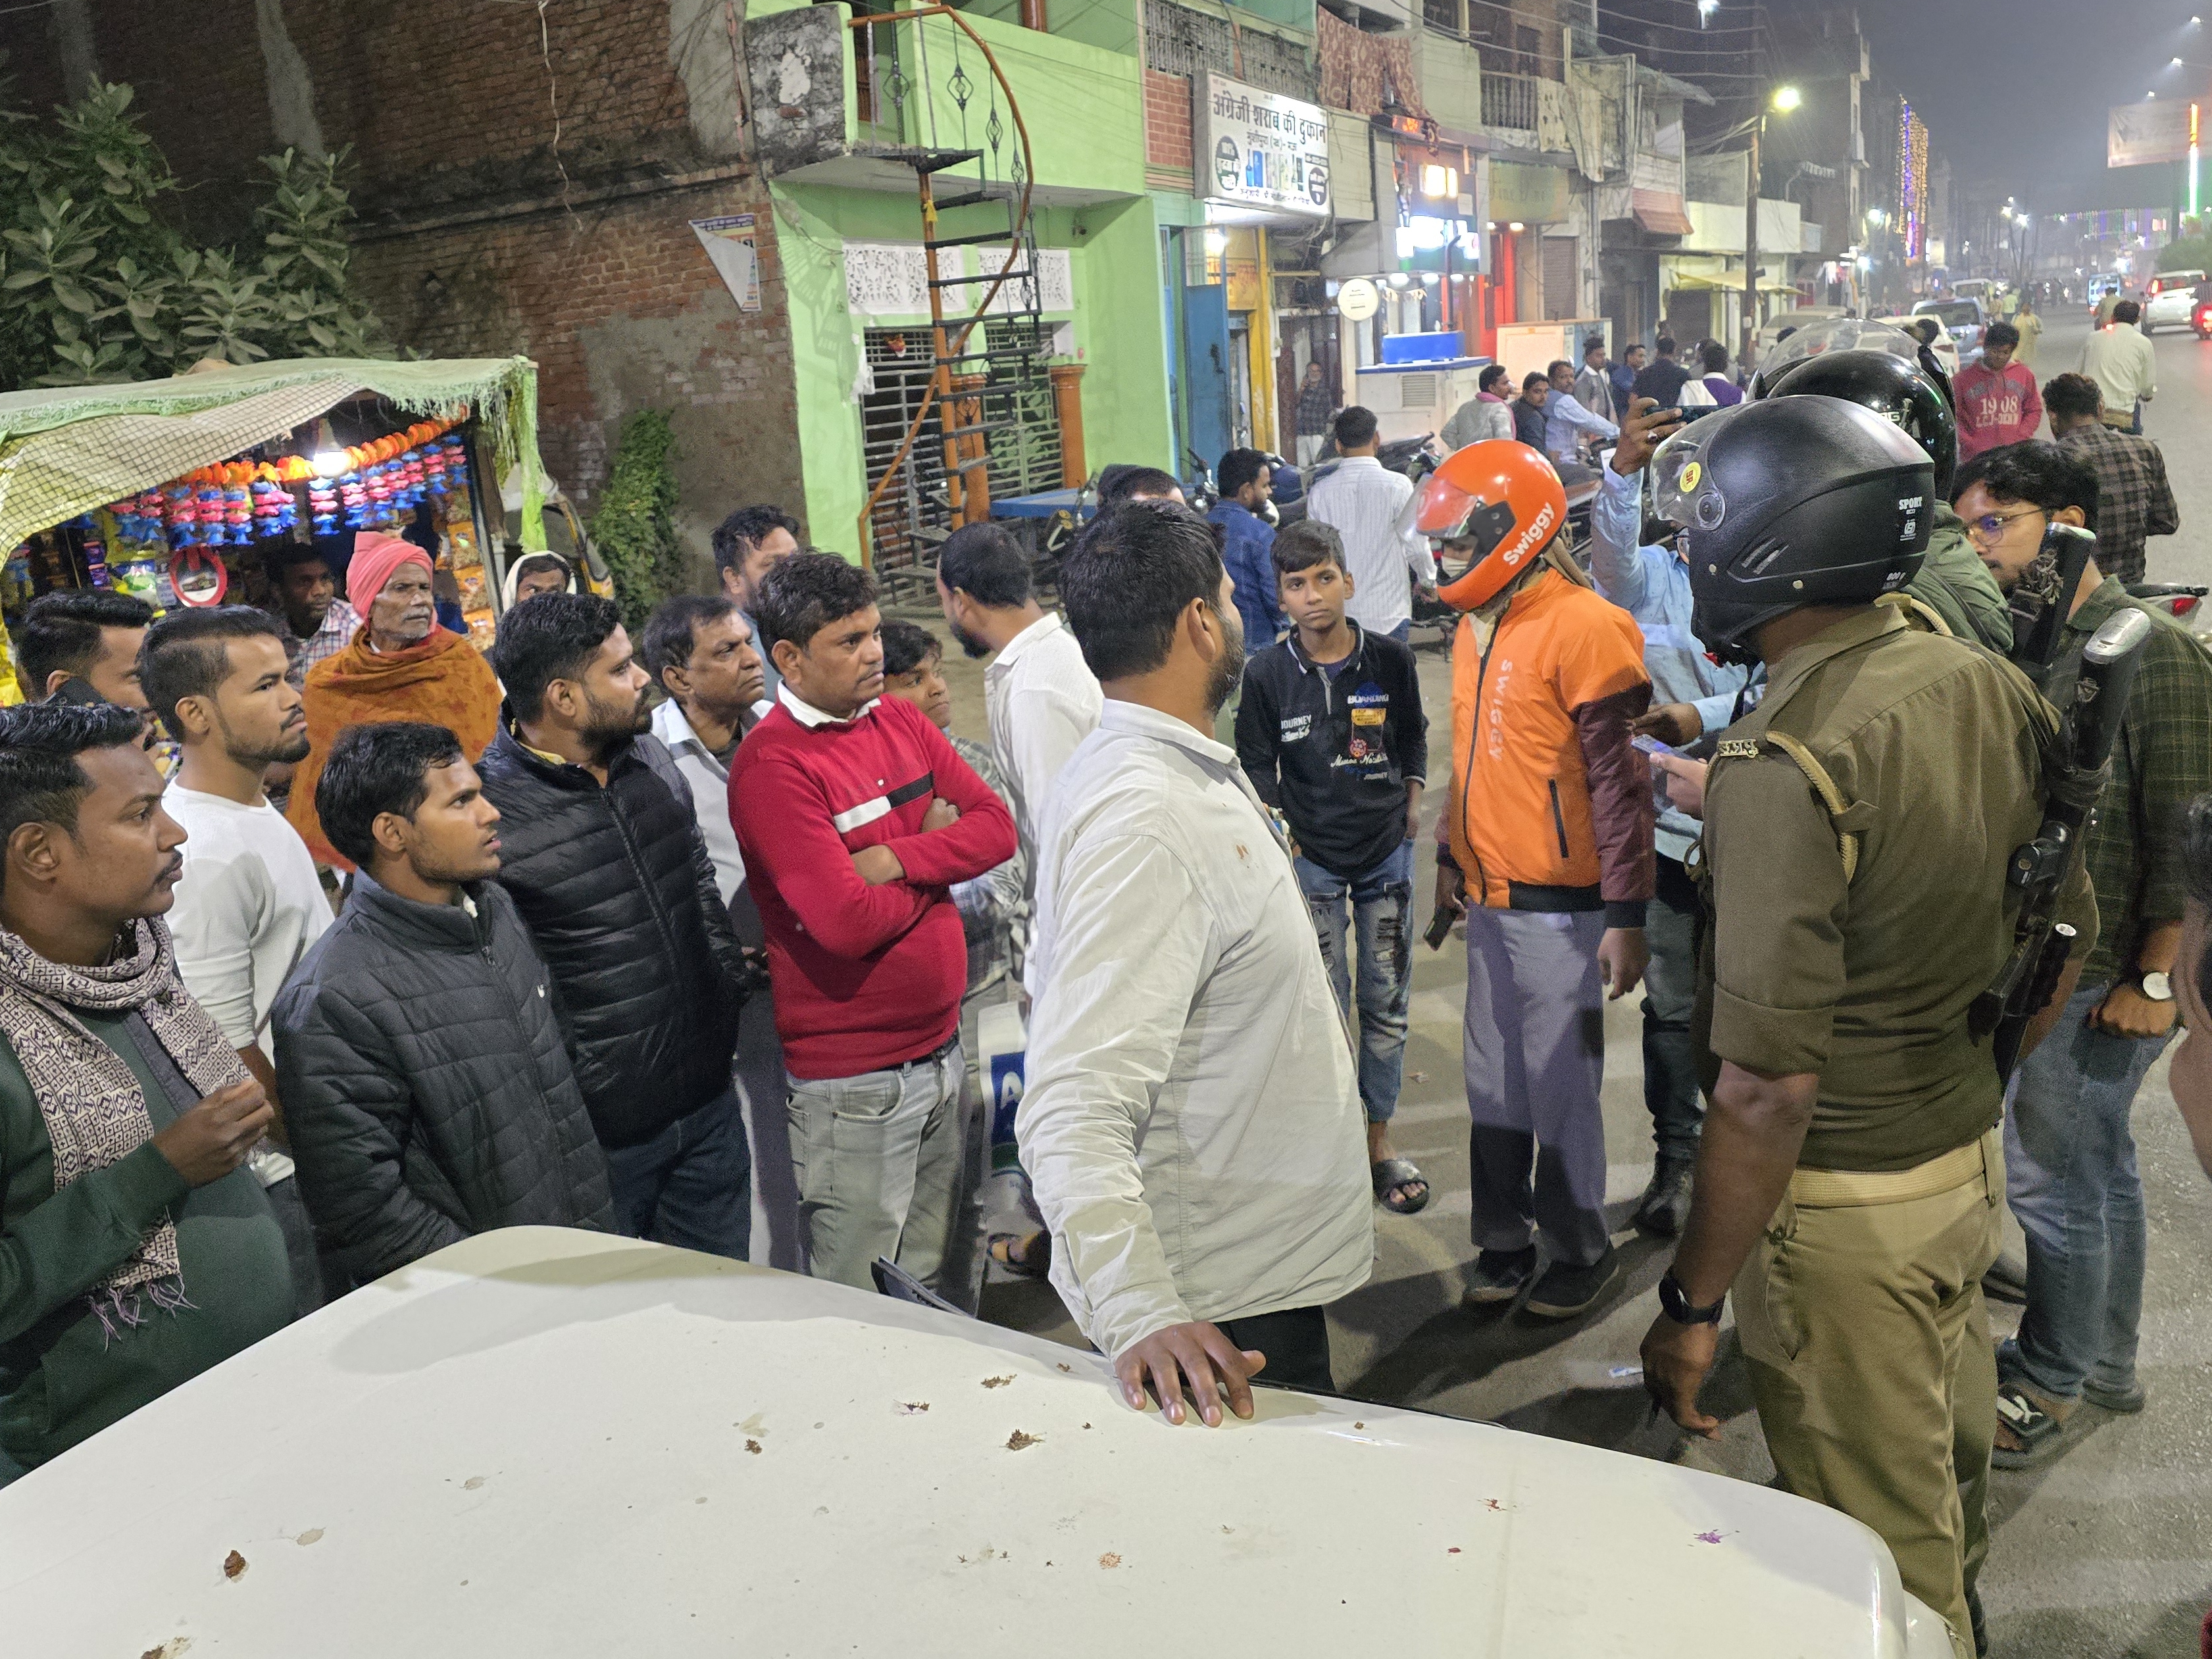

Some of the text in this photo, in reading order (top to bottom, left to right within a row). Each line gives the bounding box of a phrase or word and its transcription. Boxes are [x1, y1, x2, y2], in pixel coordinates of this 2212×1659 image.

[1213, 89, 1328, 145] अंग्रेजी शराब की दुकान
[1980, 397, 1998, 415] 19
[1899, 496, 1923, 510] SPORT
[1503, 501, 1555, 566] Swiggy
[1886, 572, 1901, 581] 800
[1488, 658, 1513, 762] SWIGGY
